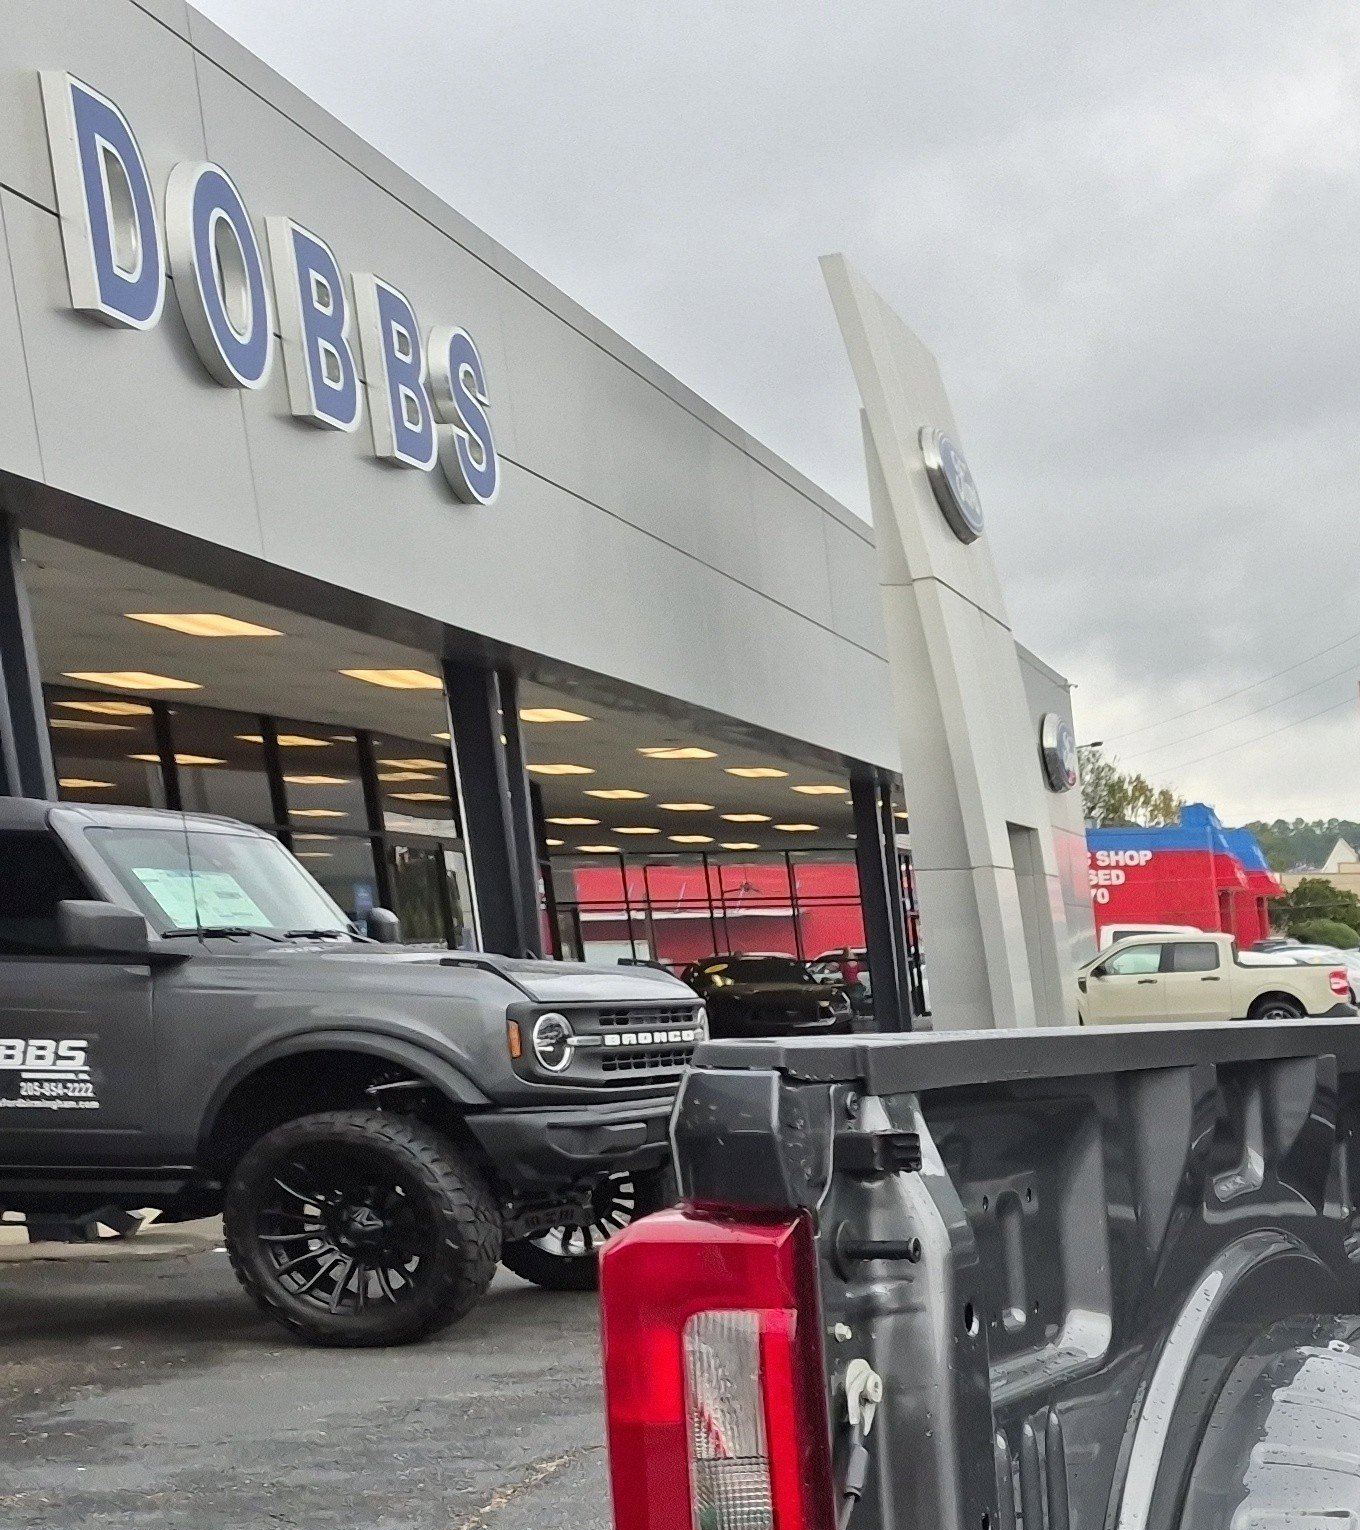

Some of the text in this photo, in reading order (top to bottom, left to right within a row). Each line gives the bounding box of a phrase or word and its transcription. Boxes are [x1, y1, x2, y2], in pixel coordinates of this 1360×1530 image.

[38, 70, 499, 505] DOBBS
[1096, 850, 1152, 866] SHOP
[604, 1029, 695, 1046] BRONCO
